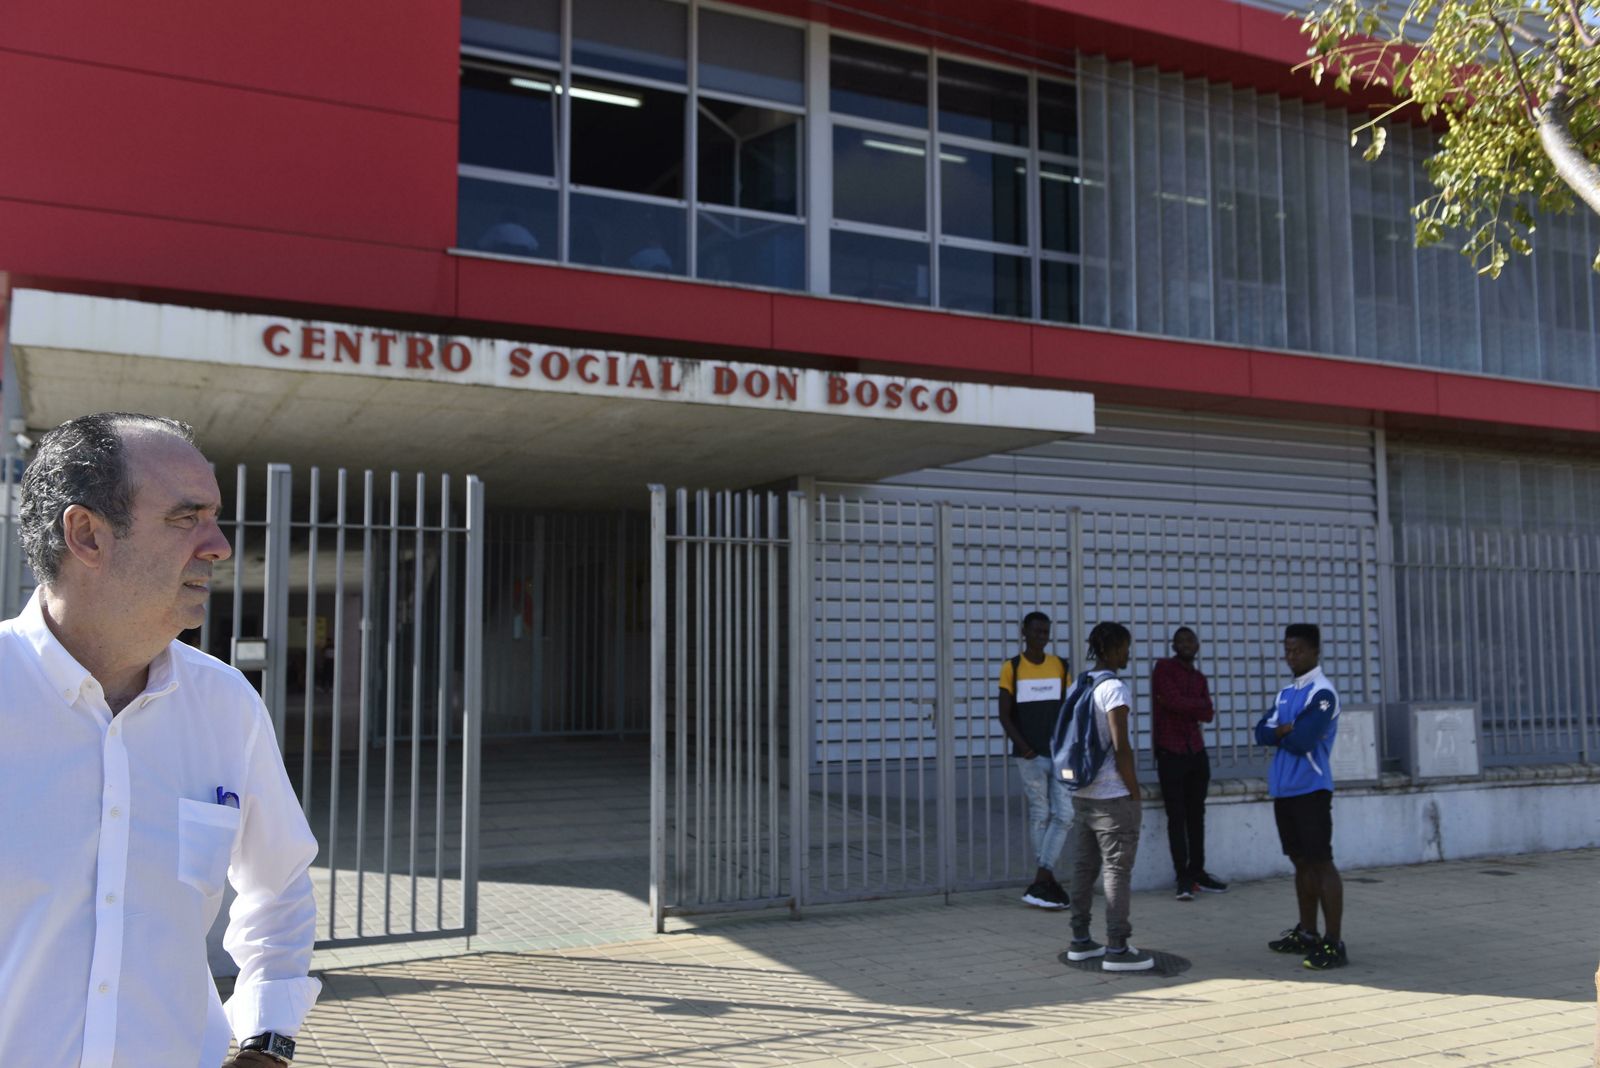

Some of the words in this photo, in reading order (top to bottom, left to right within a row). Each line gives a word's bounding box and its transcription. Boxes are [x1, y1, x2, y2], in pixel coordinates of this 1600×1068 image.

[262, 324, 472, 373] CENTRO
[509, 348, 680, 392] SOCIAL
[714, 366, 798, 401] DON
[827, 375, 959, 413] BOSCO
